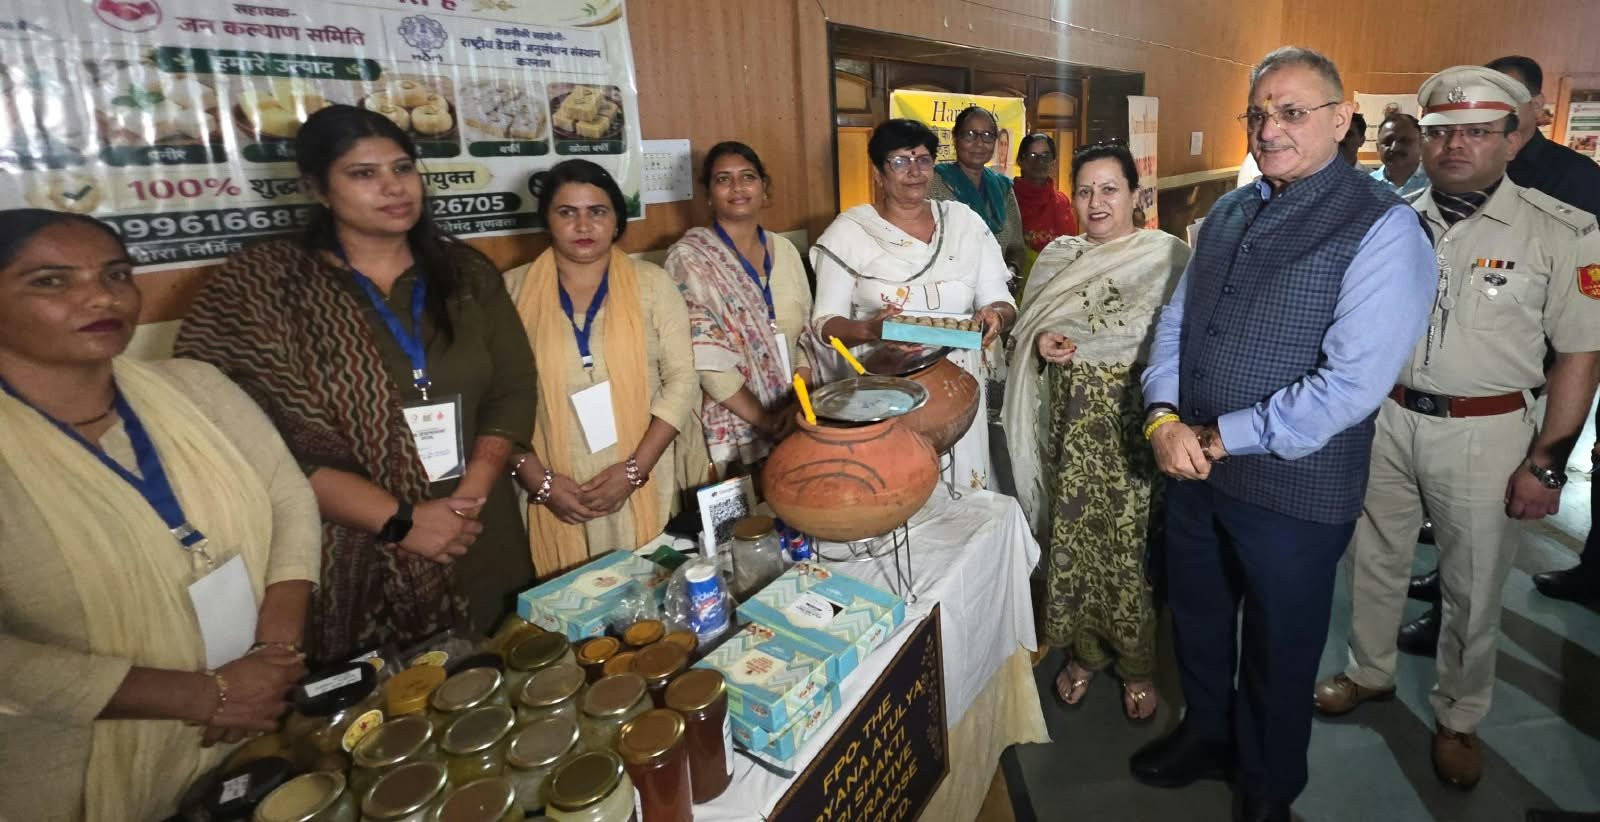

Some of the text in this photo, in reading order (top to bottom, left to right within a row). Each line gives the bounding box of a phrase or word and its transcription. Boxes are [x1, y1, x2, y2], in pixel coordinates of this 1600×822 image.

[175, 17, 365, 46] जन कल्याण समिति
[209, 53, 266, 73] हमारे
[932, 101, 964, 122] Har
[127, 177, 241, 202] 100%
[862, 693, 892, 739] THE
[855, 725, 905, 808] SHAKTI
